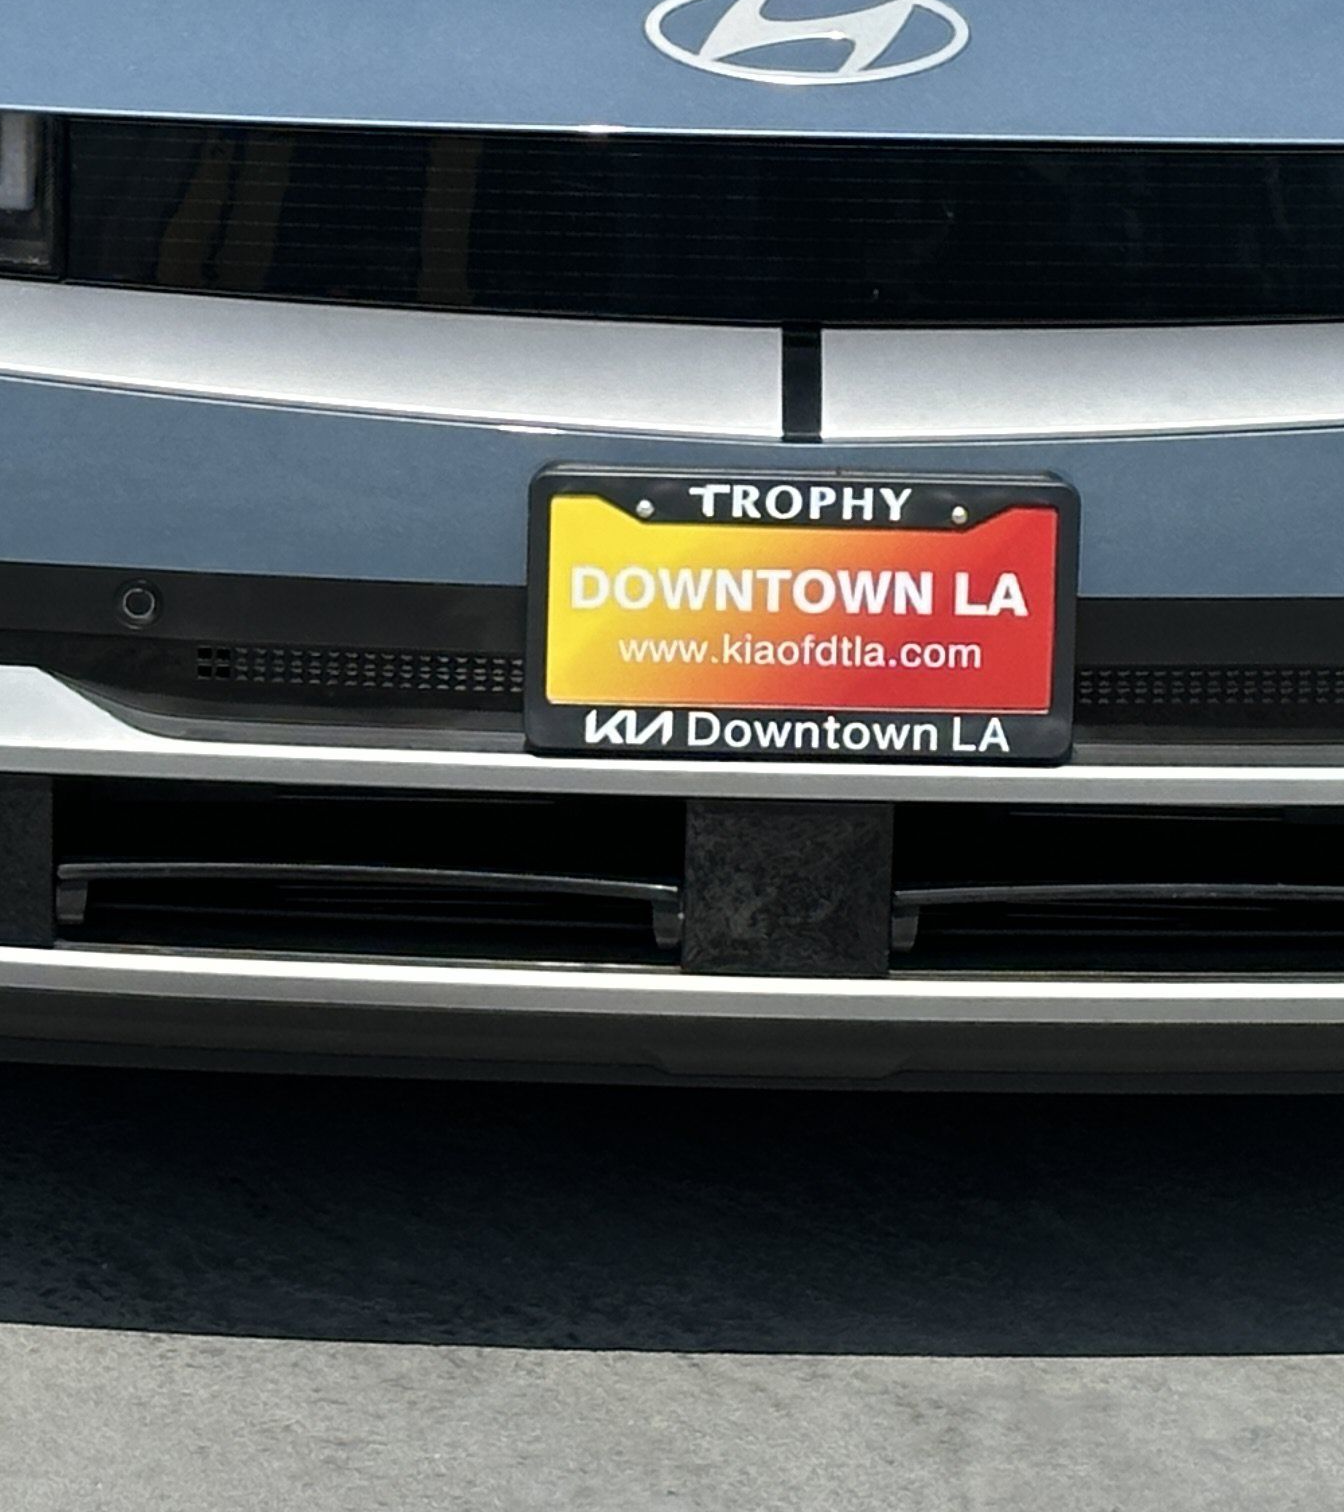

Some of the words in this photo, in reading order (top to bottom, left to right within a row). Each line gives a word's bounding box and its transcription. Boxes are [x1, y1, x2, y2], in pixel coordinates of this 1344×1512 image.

[689, 484, 912, 522] TROPHY
[569, 564, 934, 616] DOWNTOWN
[953, 570, 1029, 617] LA
[618, 632, 983, 669] www.kiaofdtla.com
[687, 710, 939, 753] Downtown
[951, 715, 1011, 753] LA
